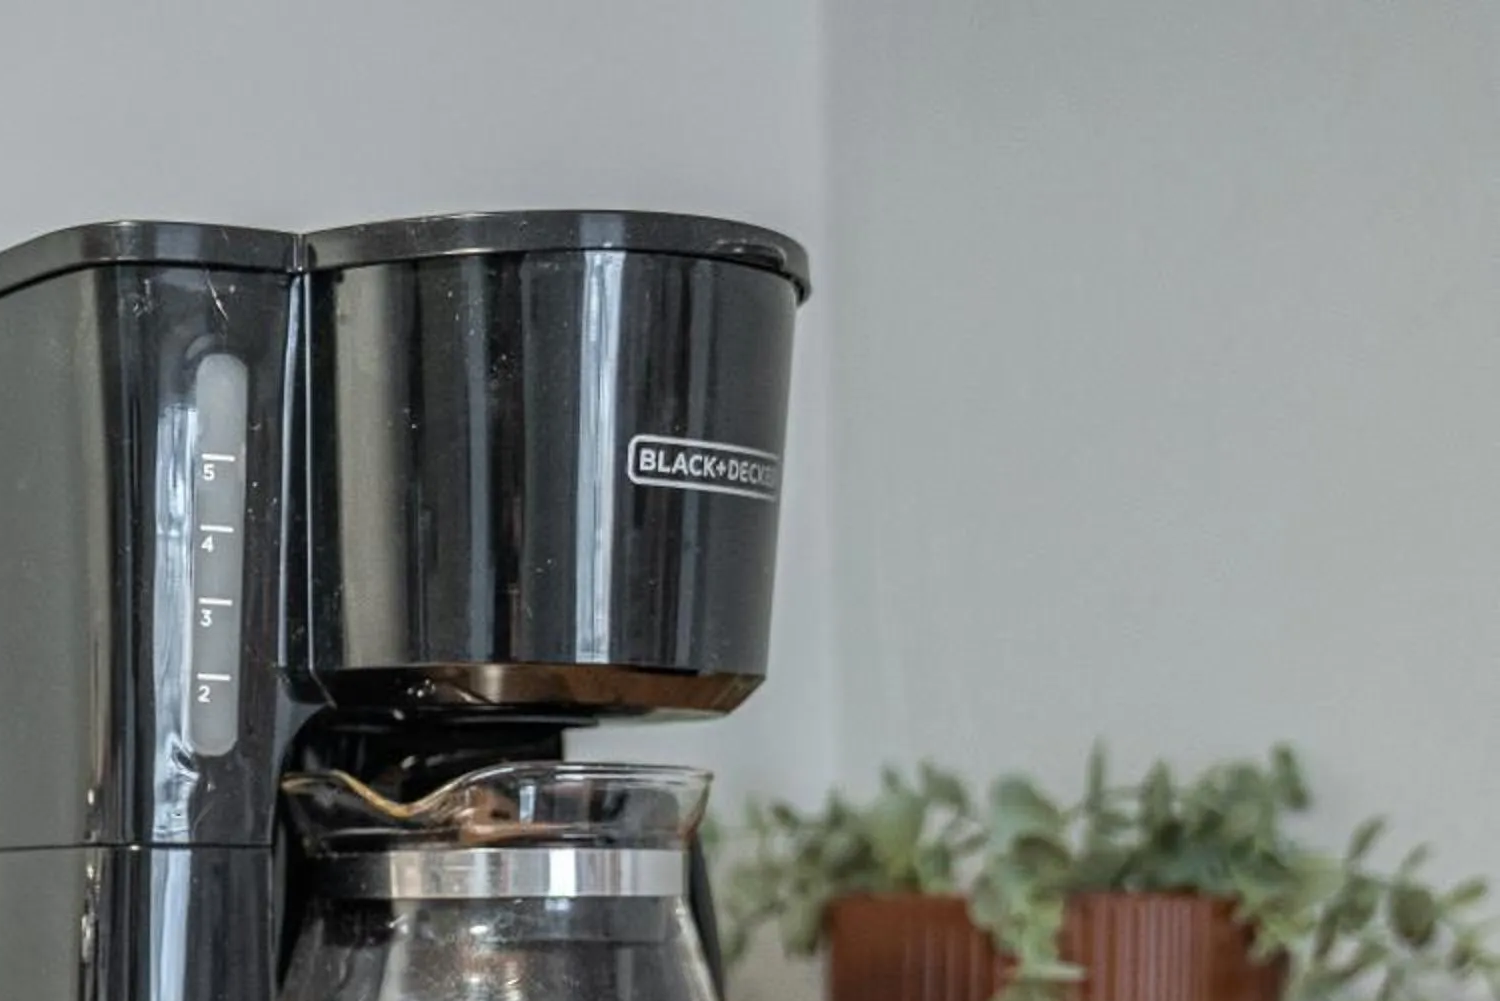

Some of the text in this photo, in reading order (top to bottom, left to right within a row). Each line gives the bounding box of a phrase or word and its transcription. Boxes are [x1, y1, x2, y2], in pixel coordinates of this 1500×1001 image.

[202, 463, 216, 482] 5
[201, 536, 214, 553] 4
[201, 609, 213, 628] 3
[197, 685, 211, 703] 2
